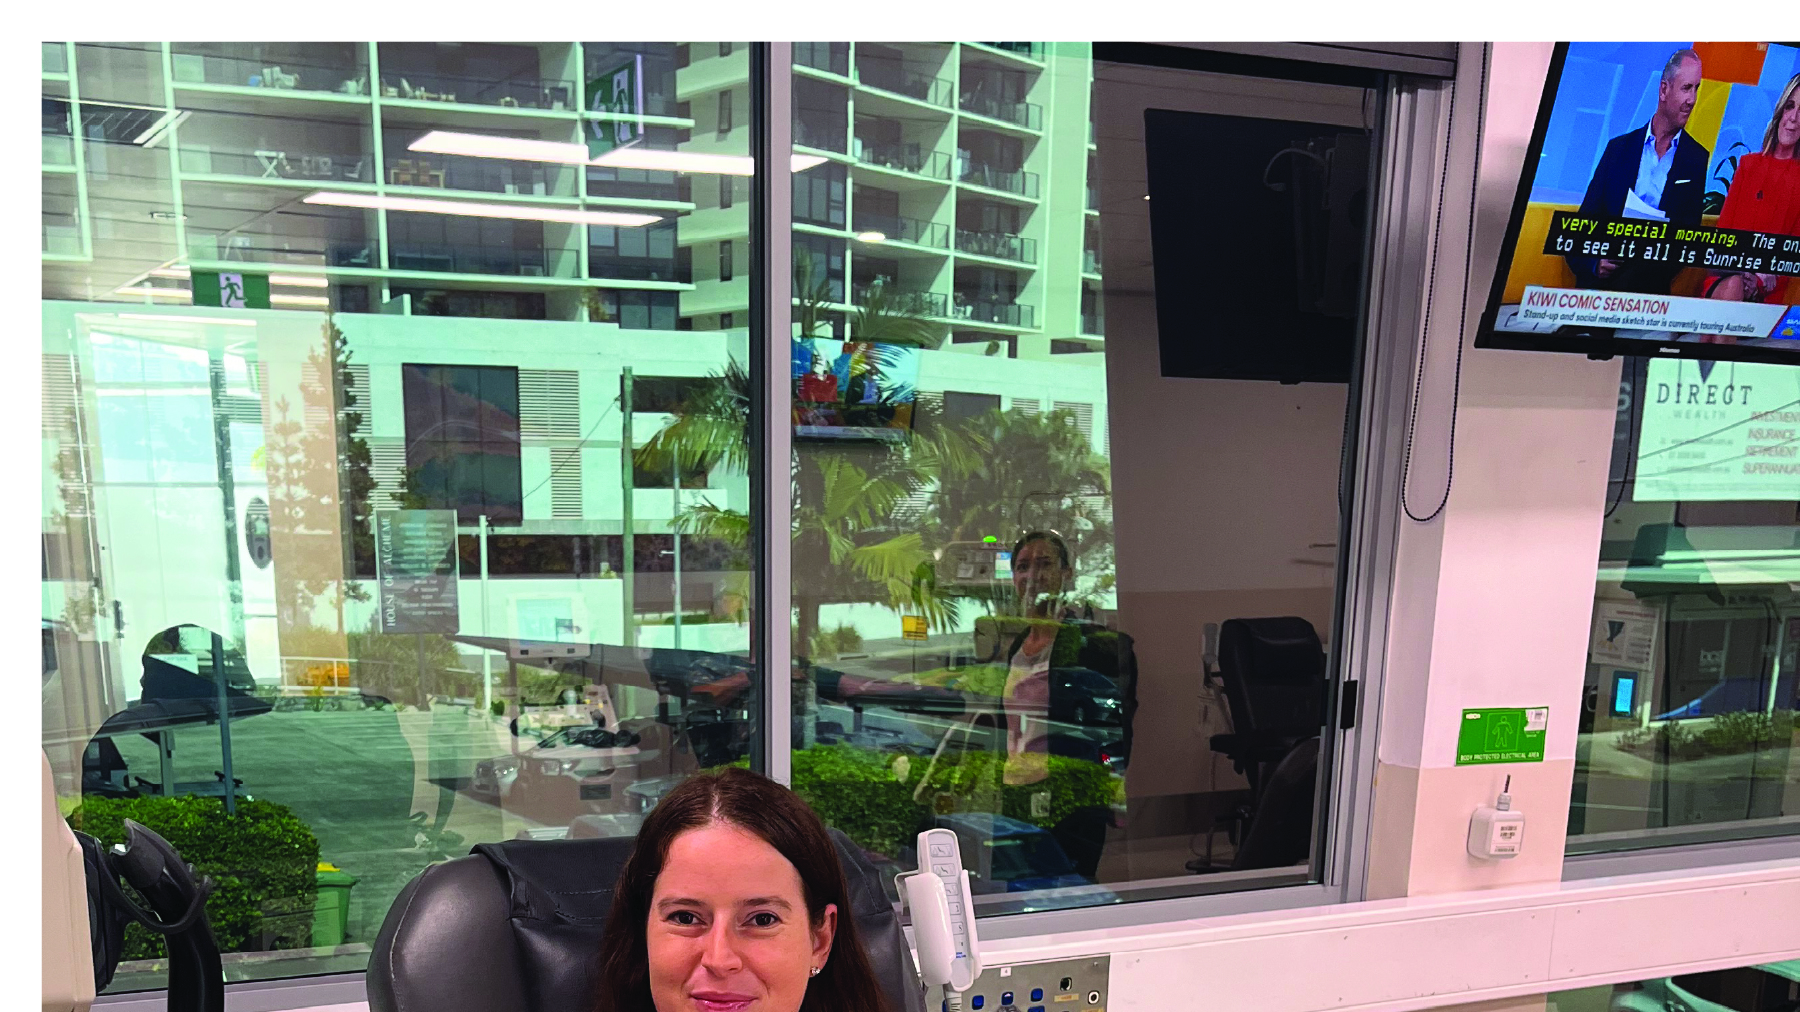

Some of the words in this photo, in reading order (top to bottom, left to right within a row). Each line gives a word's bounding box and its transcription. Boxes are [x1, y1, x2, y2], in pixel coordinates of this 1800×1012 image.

[1561, 215, 1598, 235] very
[1606, 220, 1667, 240] special
[1752, 233, 1776, 251] The
[1782, 239, 1800, 254] on
[1556, 234, 1573, 252] to
[1582, 239, 1610, 255] see
[1617, 240, 1636, 258] it
[1643, 242, 1669, 261] all
[1678, 245, 1695, 264] is
[1703, 248, 1763, 271] Sunrise
[1527, 291, 1557, 308] KIWI
[1559, 293, 1601, 311] COMIC
[1603, 296, 1670, 316] SENSATION
[1523, 309, 1559, 322] Stand-up
[1559, 311, 1575, 321] and
[1576, 312, 1598, 323] social
[1598, 314, 1621, 324] media
[1622, 315, 1646, 326] sketch
[1646, 316, 1660, 327] star
[1668, 318, 1700, 331] currently
[1700, 320, 1724, 333] touring
[1725, 322, 1756, 333] Australia
[1656, 383, 1753, 405] DIRECT
[382, 573, 395, 587] OF
[385, 594, 396, 627] HOUSE
